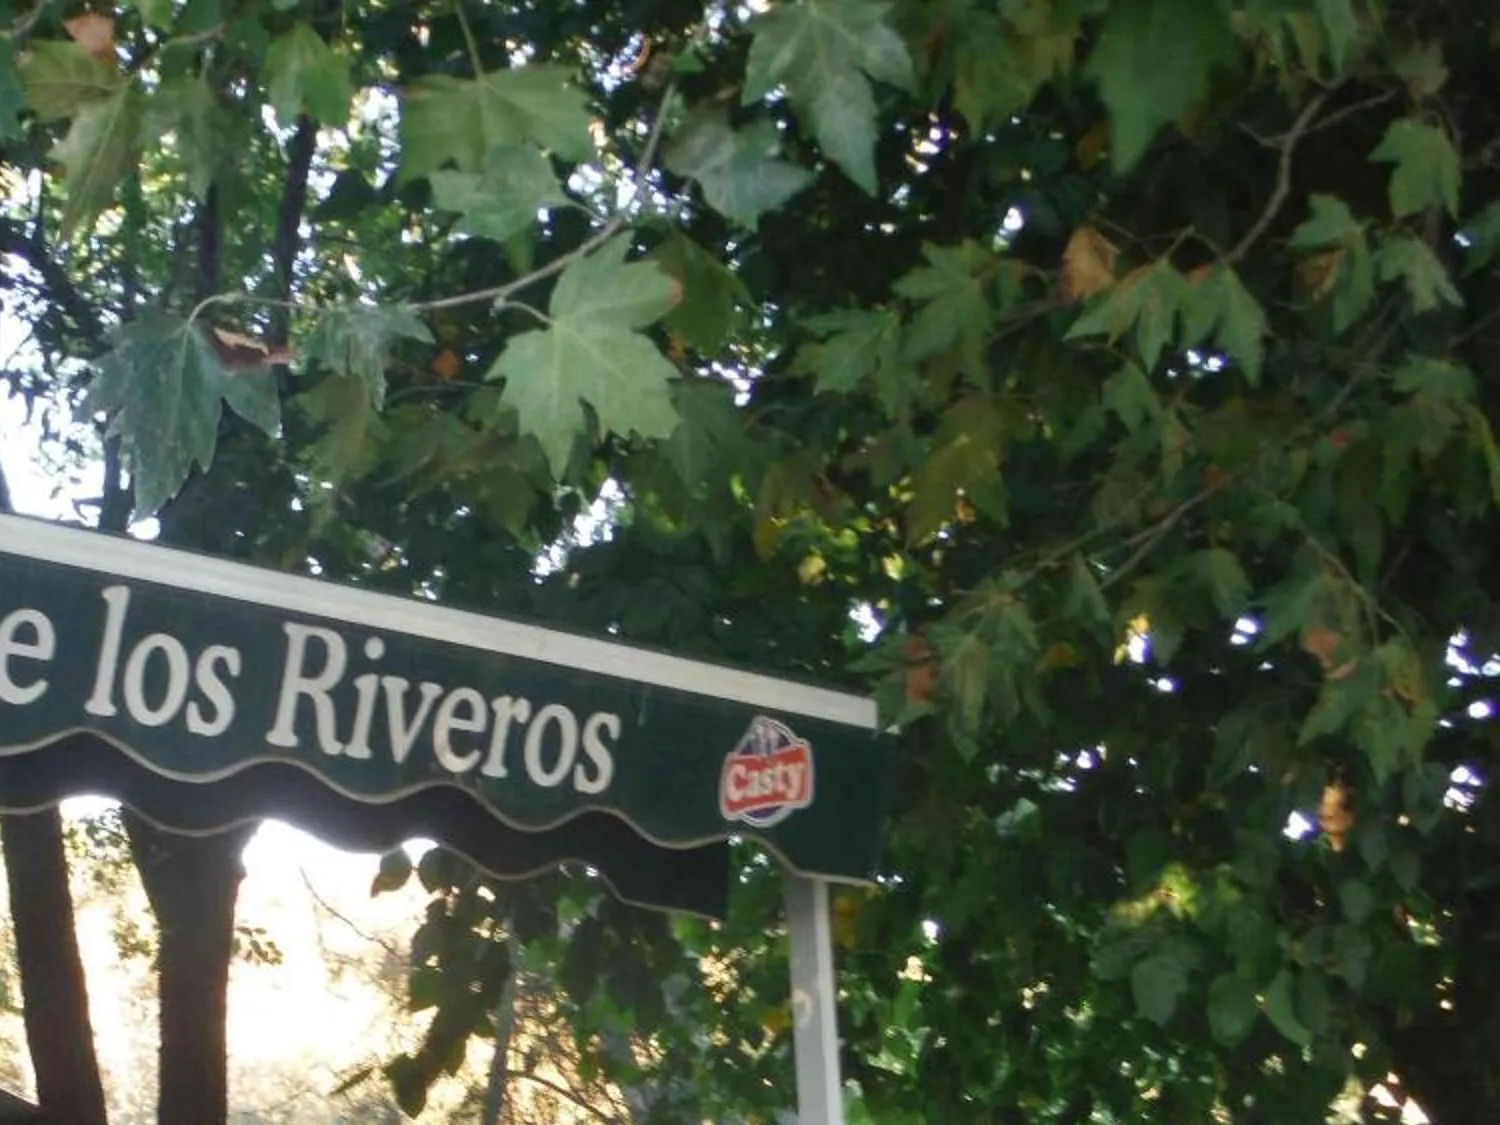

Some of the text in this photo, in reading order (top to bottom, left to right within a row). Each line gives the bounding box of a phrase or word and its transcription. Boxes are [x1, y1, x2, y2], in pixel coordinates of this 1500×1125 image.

[84, 585, 242, 737] los
[266, 621, 622, 795] Riveros
[727, 761, 805, 801] Casty
